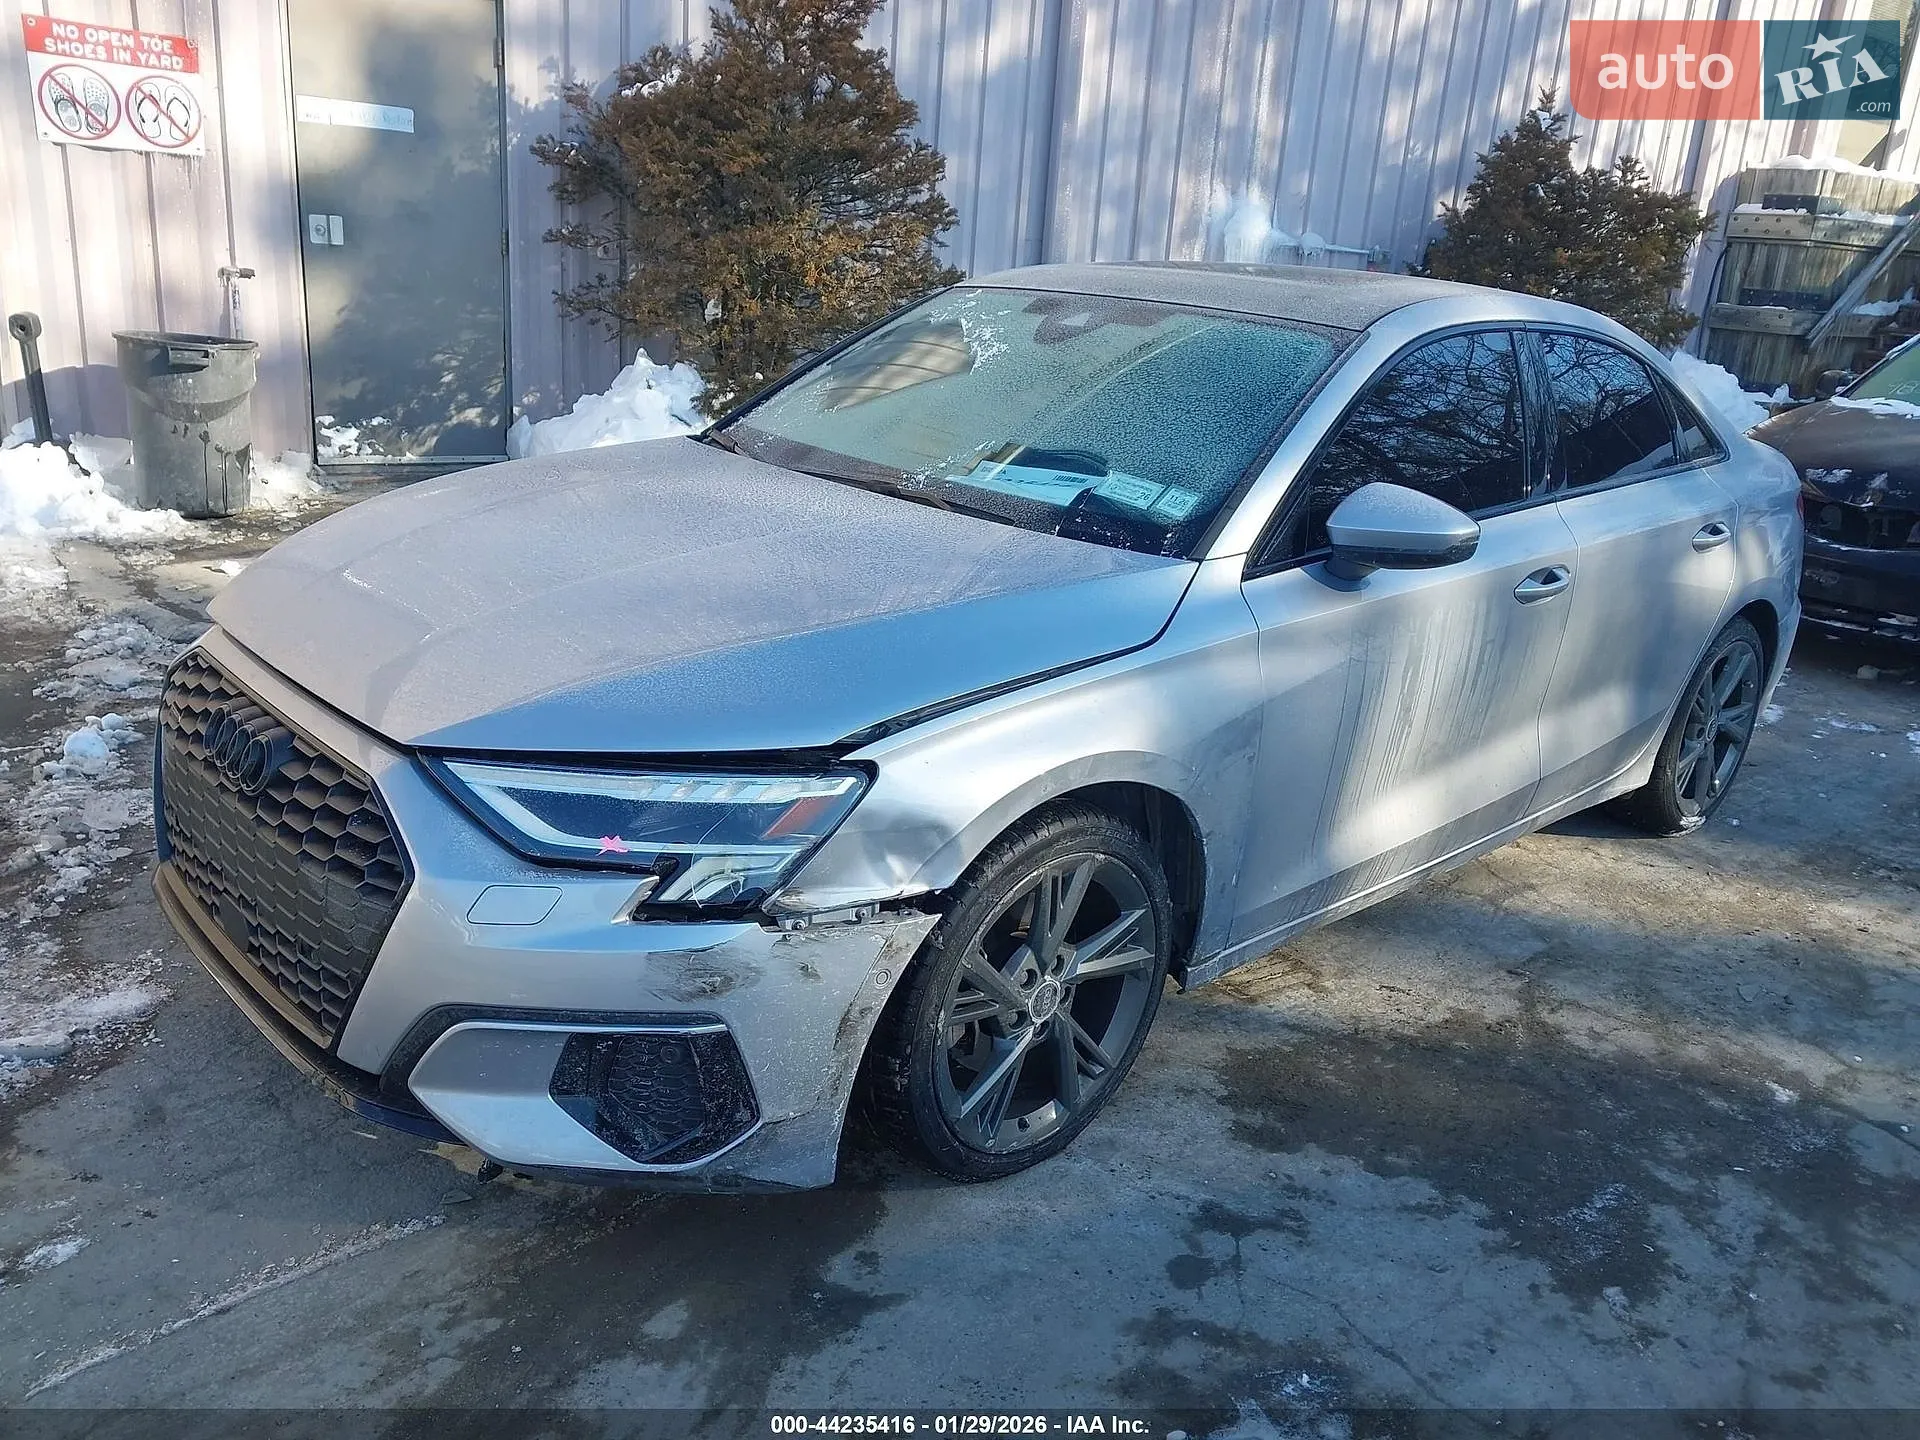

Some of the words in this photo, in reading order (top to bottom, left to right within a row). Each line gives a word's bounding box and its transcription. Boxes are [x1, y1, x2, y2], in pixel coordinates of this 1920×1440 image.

[44, 37, 107, 61] SHOES
[112, 47, 132, 63] IN
[137, 50, 184, 71] YARD
[52, 23, 80, 39] NO
[84, 27, 135, 49] OPEN
[140, 35, 173, 54] TOE
